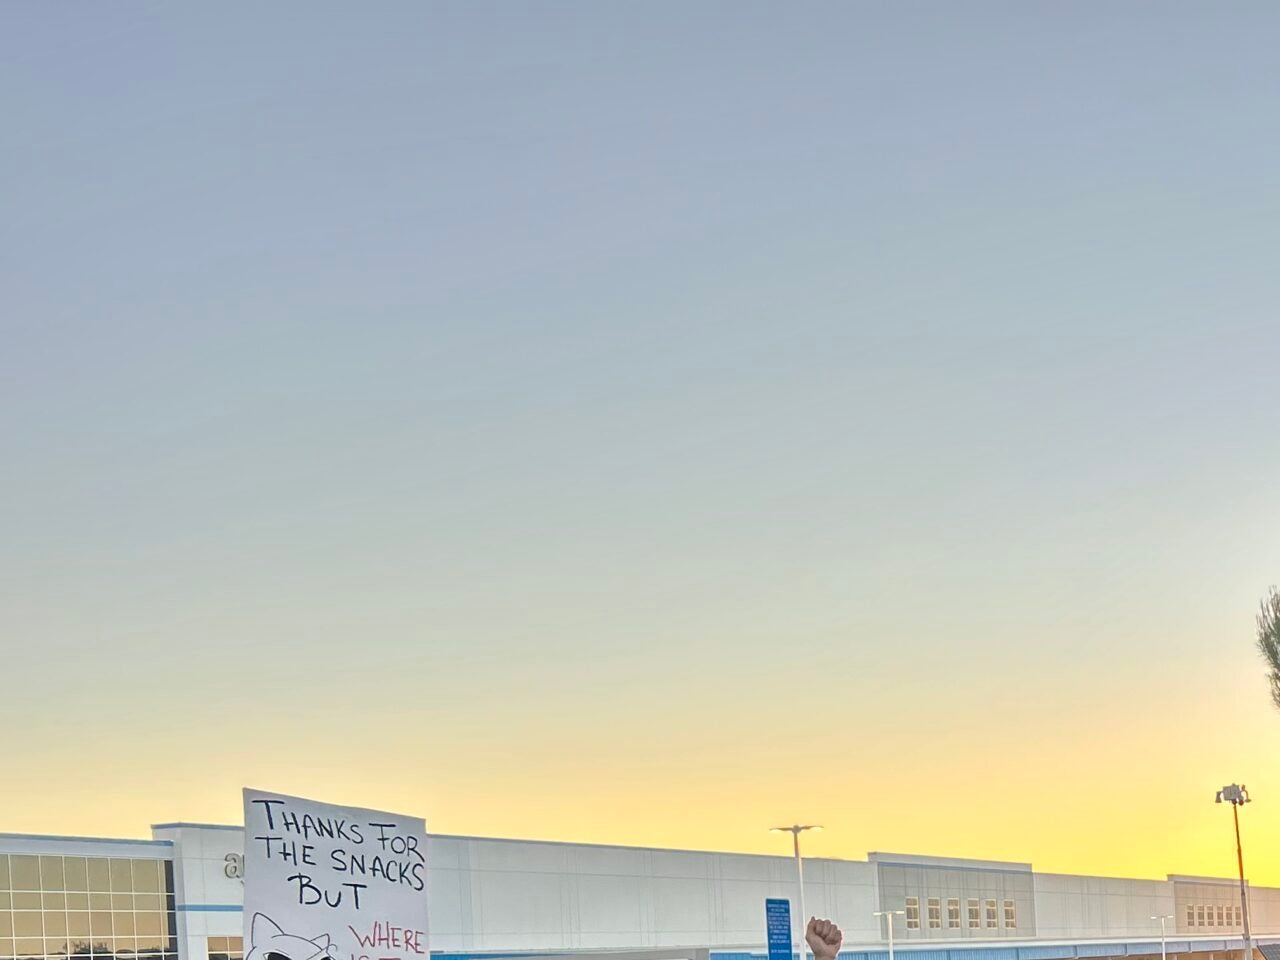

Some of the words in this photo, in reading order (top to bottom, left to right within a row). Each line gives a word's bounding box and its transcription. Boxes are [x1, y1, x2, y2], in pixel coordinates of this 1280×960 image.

[252, 801, 364, 844] THANKS
[369, 823, 425, 862] FOR
[255, 837, 316, 867] THE
[331, 849, 425, 891] SNACKS
[288, 873, 367, 909] BUT
[348, 921, 425, 954] WHERE
